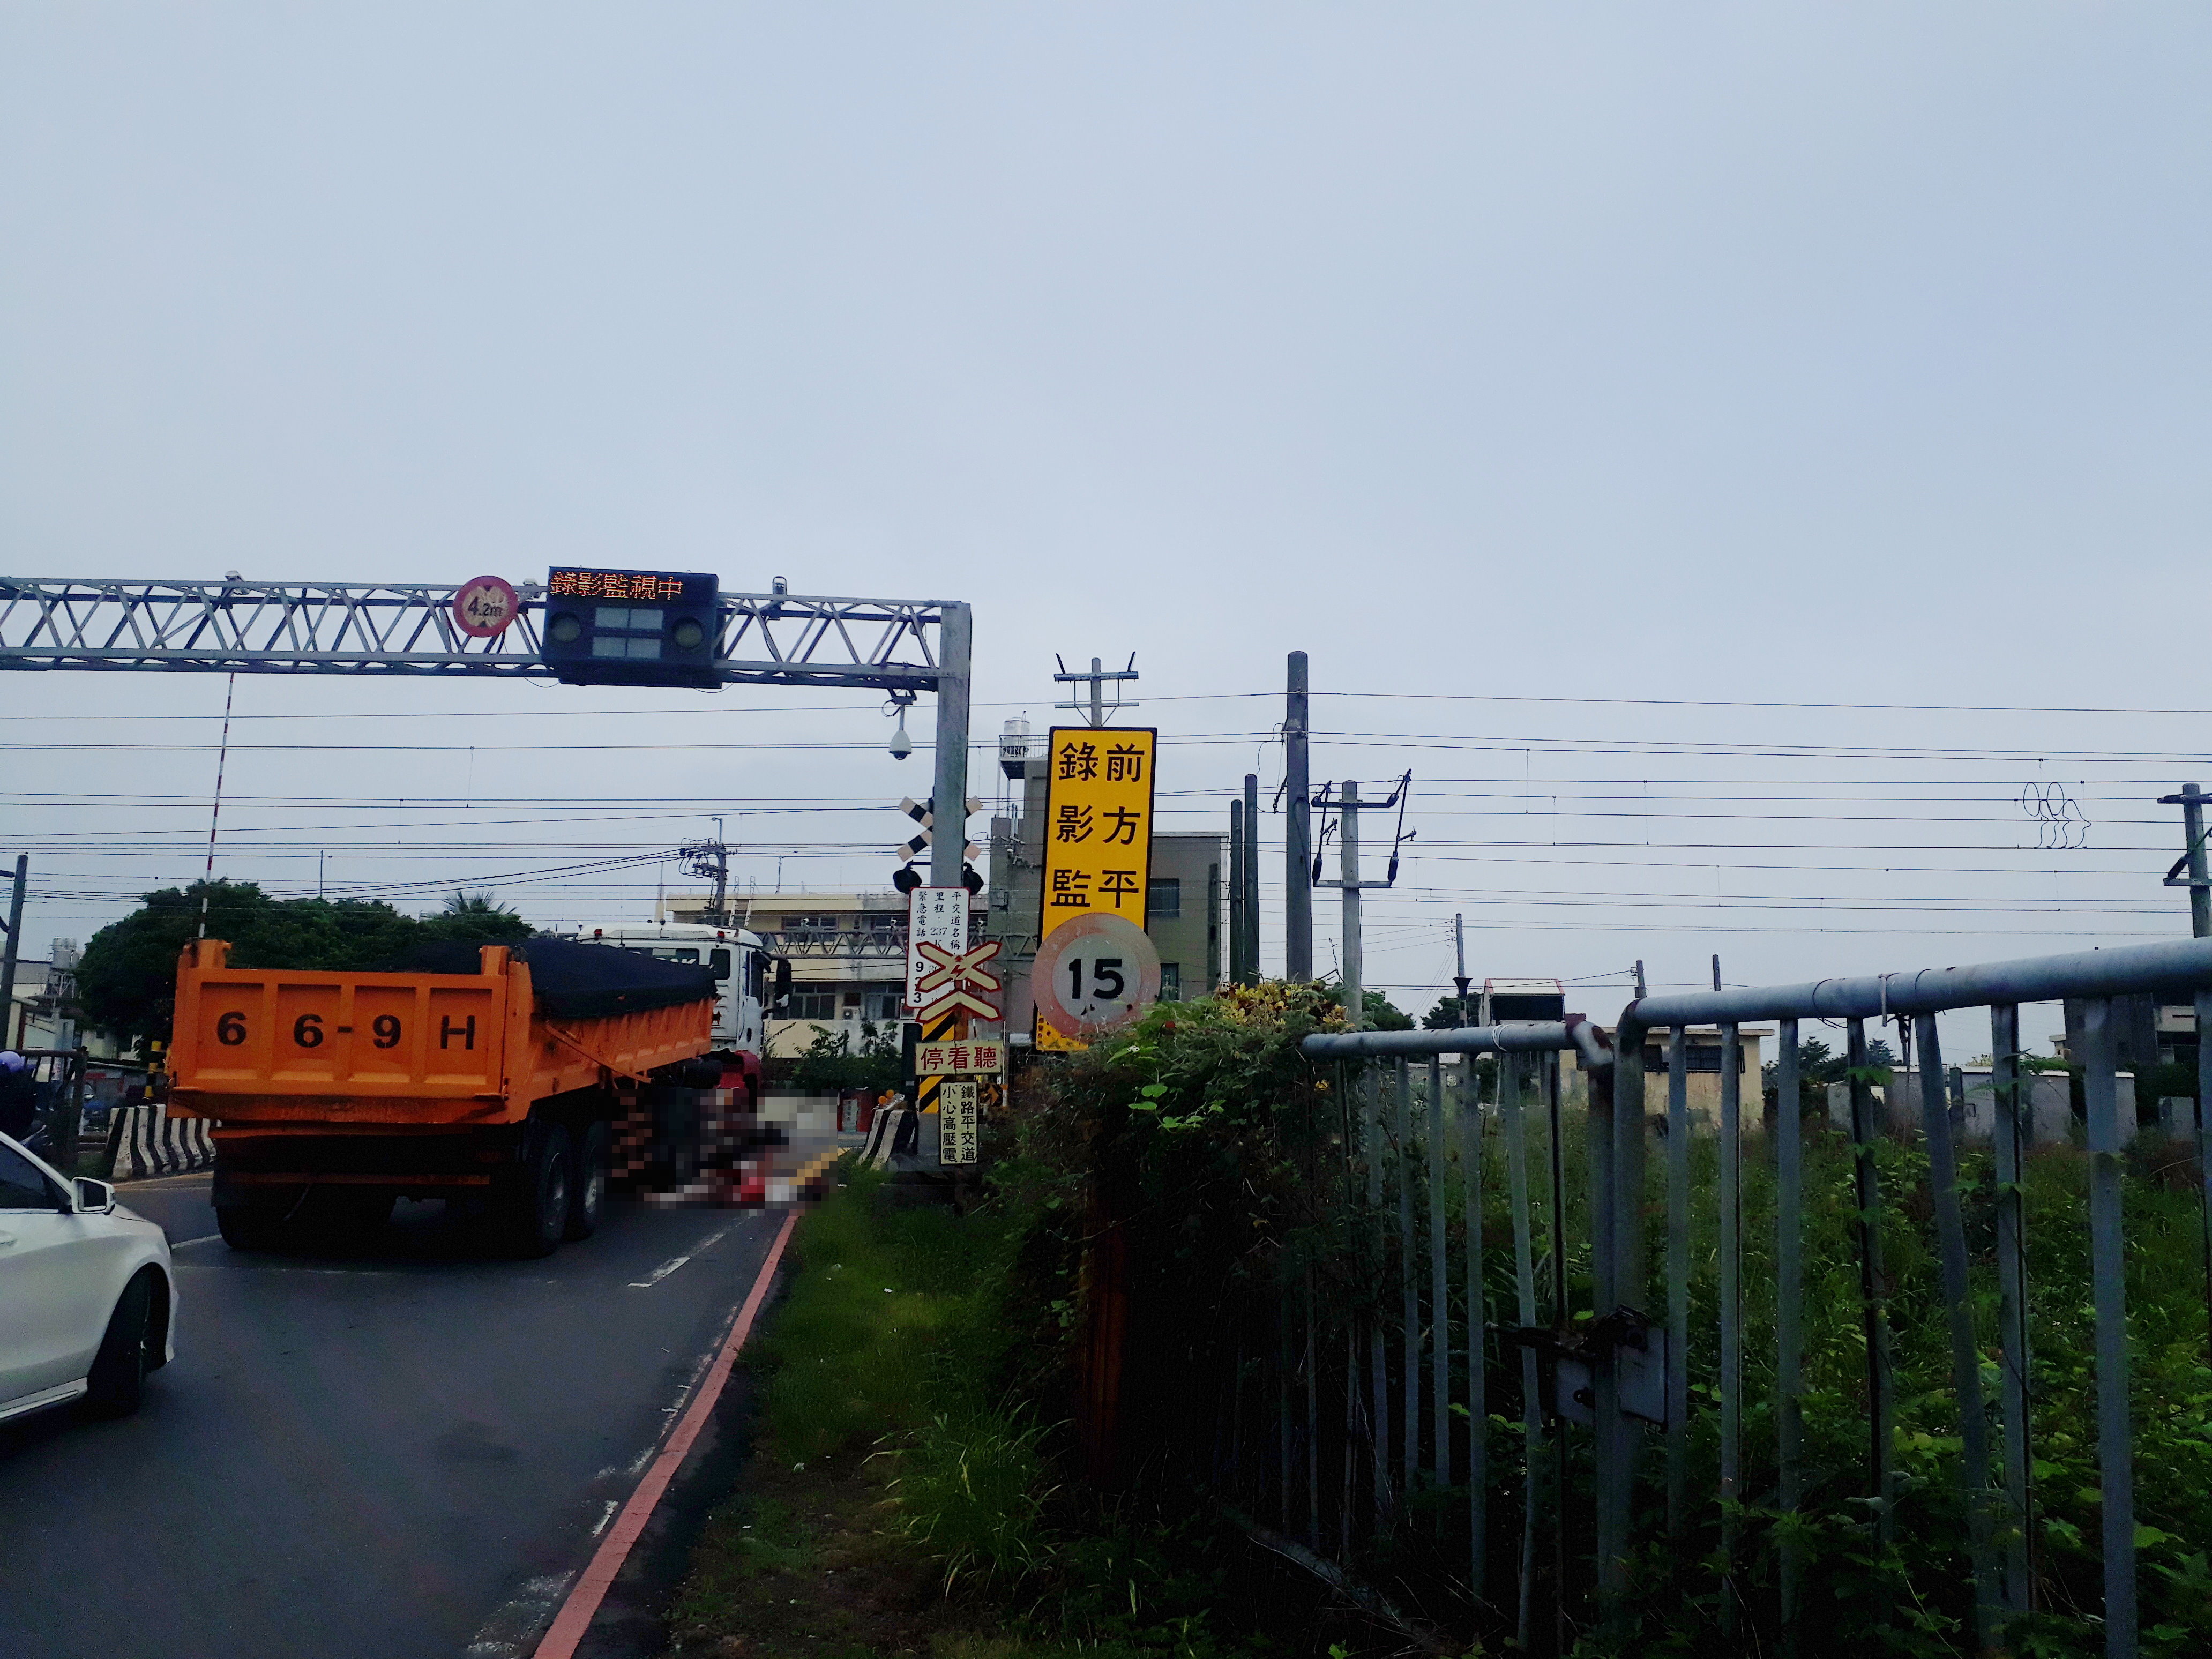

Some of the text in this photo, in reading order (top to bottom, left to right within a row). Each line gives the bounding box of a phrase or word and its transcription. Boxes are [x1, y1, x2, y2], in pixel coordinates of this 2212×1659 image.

[550, 571, 683, 601] 錄影監視中
[1098, 742, 1146, 909] 前方平
[1068, 958, 1125, 1000] 15
[920, 1046, 997, 1071] 停看聽
[943, 1086, 956, 1162] 小心高壓電
[960, 1085, 975, 1161] 鐵路平交道
